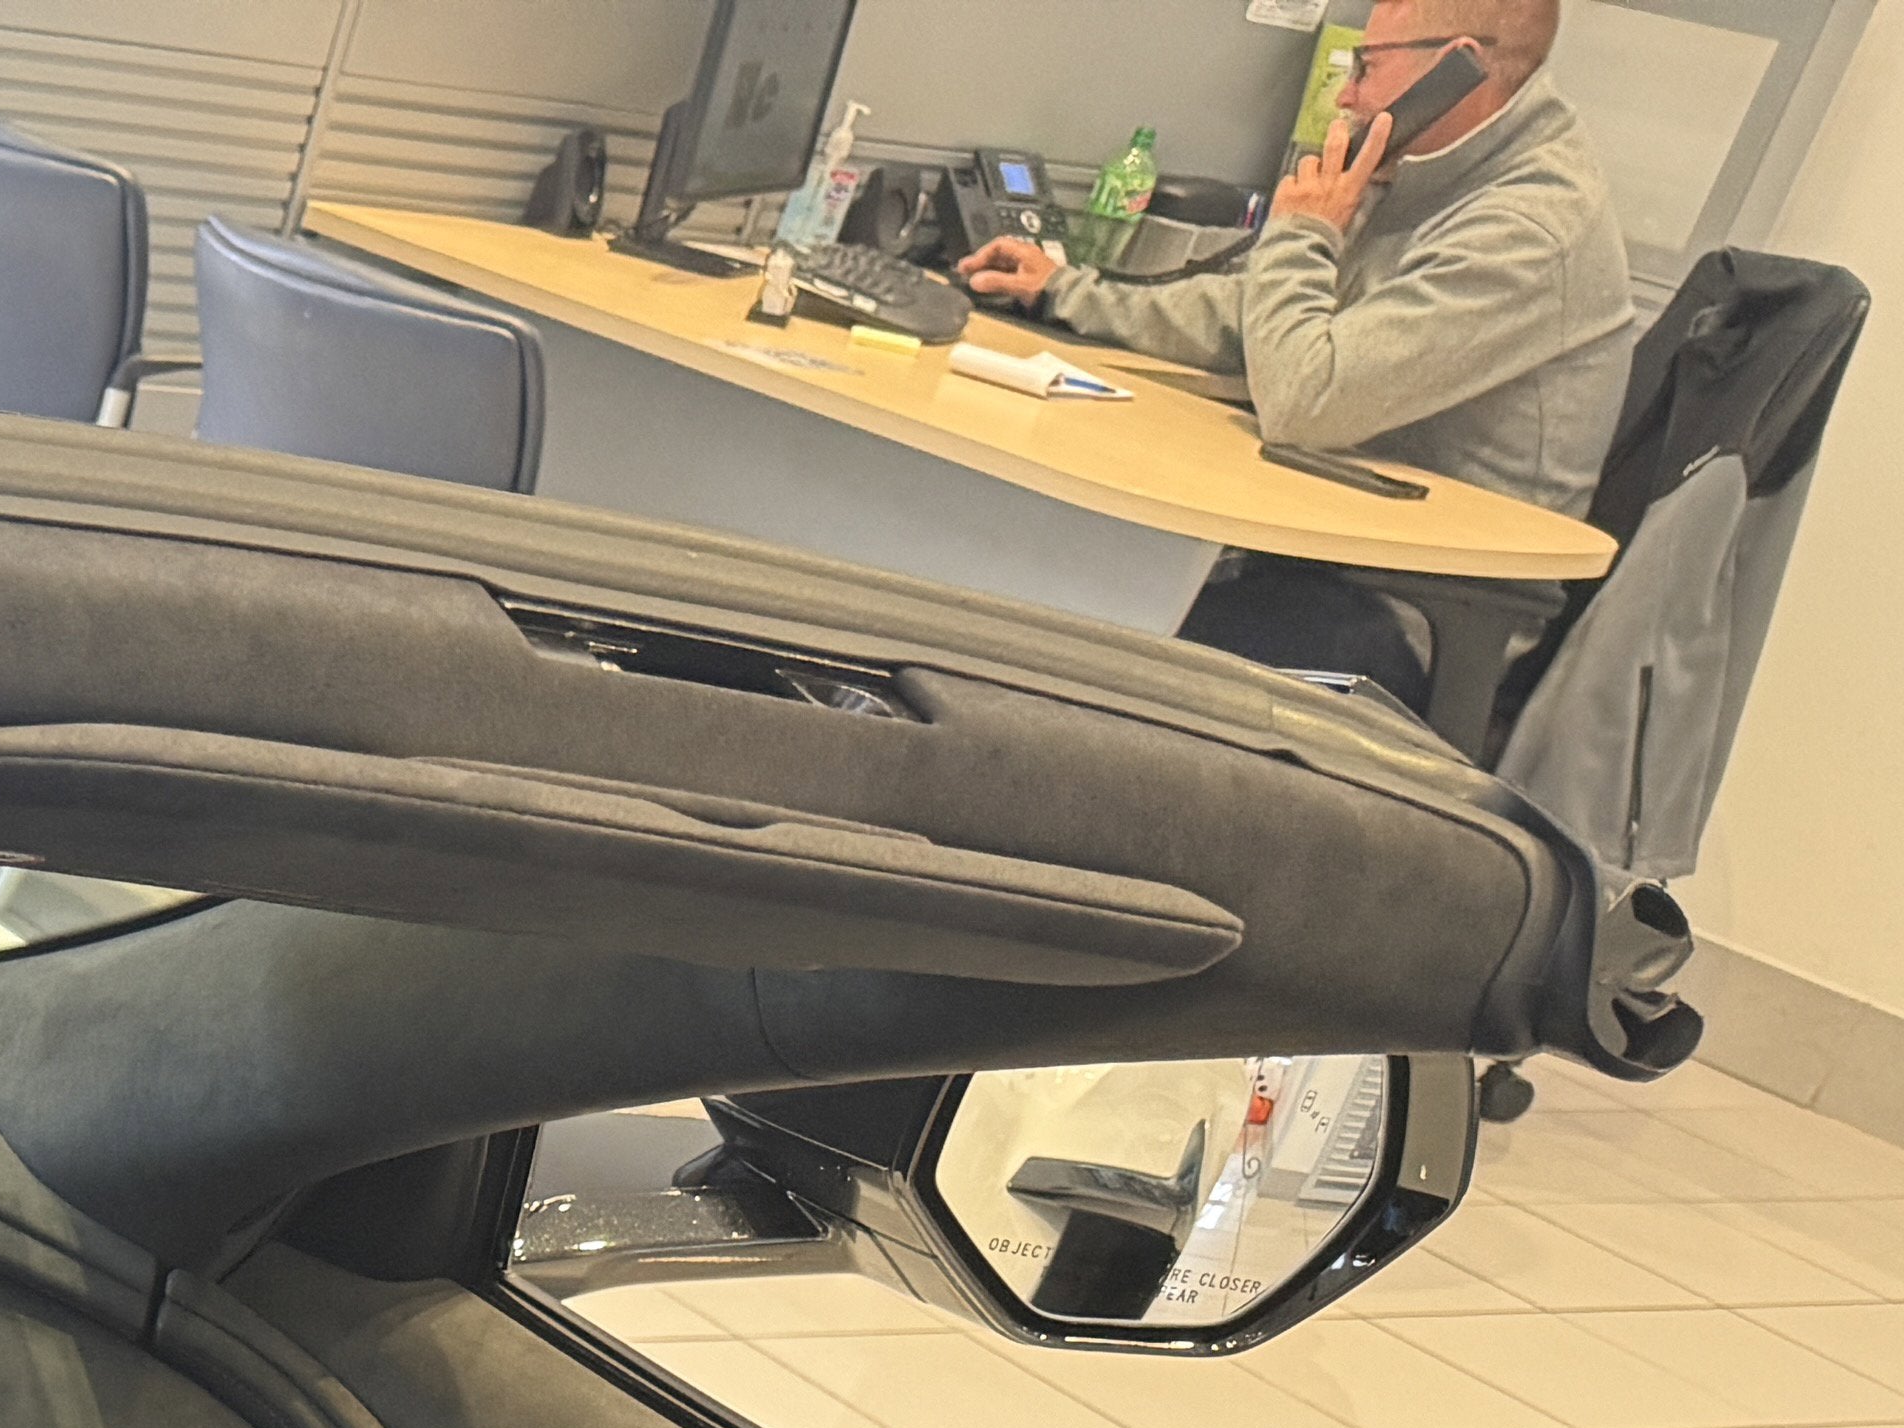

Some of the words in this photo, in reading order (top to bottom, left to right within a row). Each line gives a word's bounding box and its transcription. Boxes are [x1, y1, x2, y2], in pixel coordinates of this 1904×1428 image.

[988, 1237, 1052, 1260] OBJECT
[1170, 1268, 1192, 1284] RE
[1199, 1272, 1262, 1294] CLOSER
